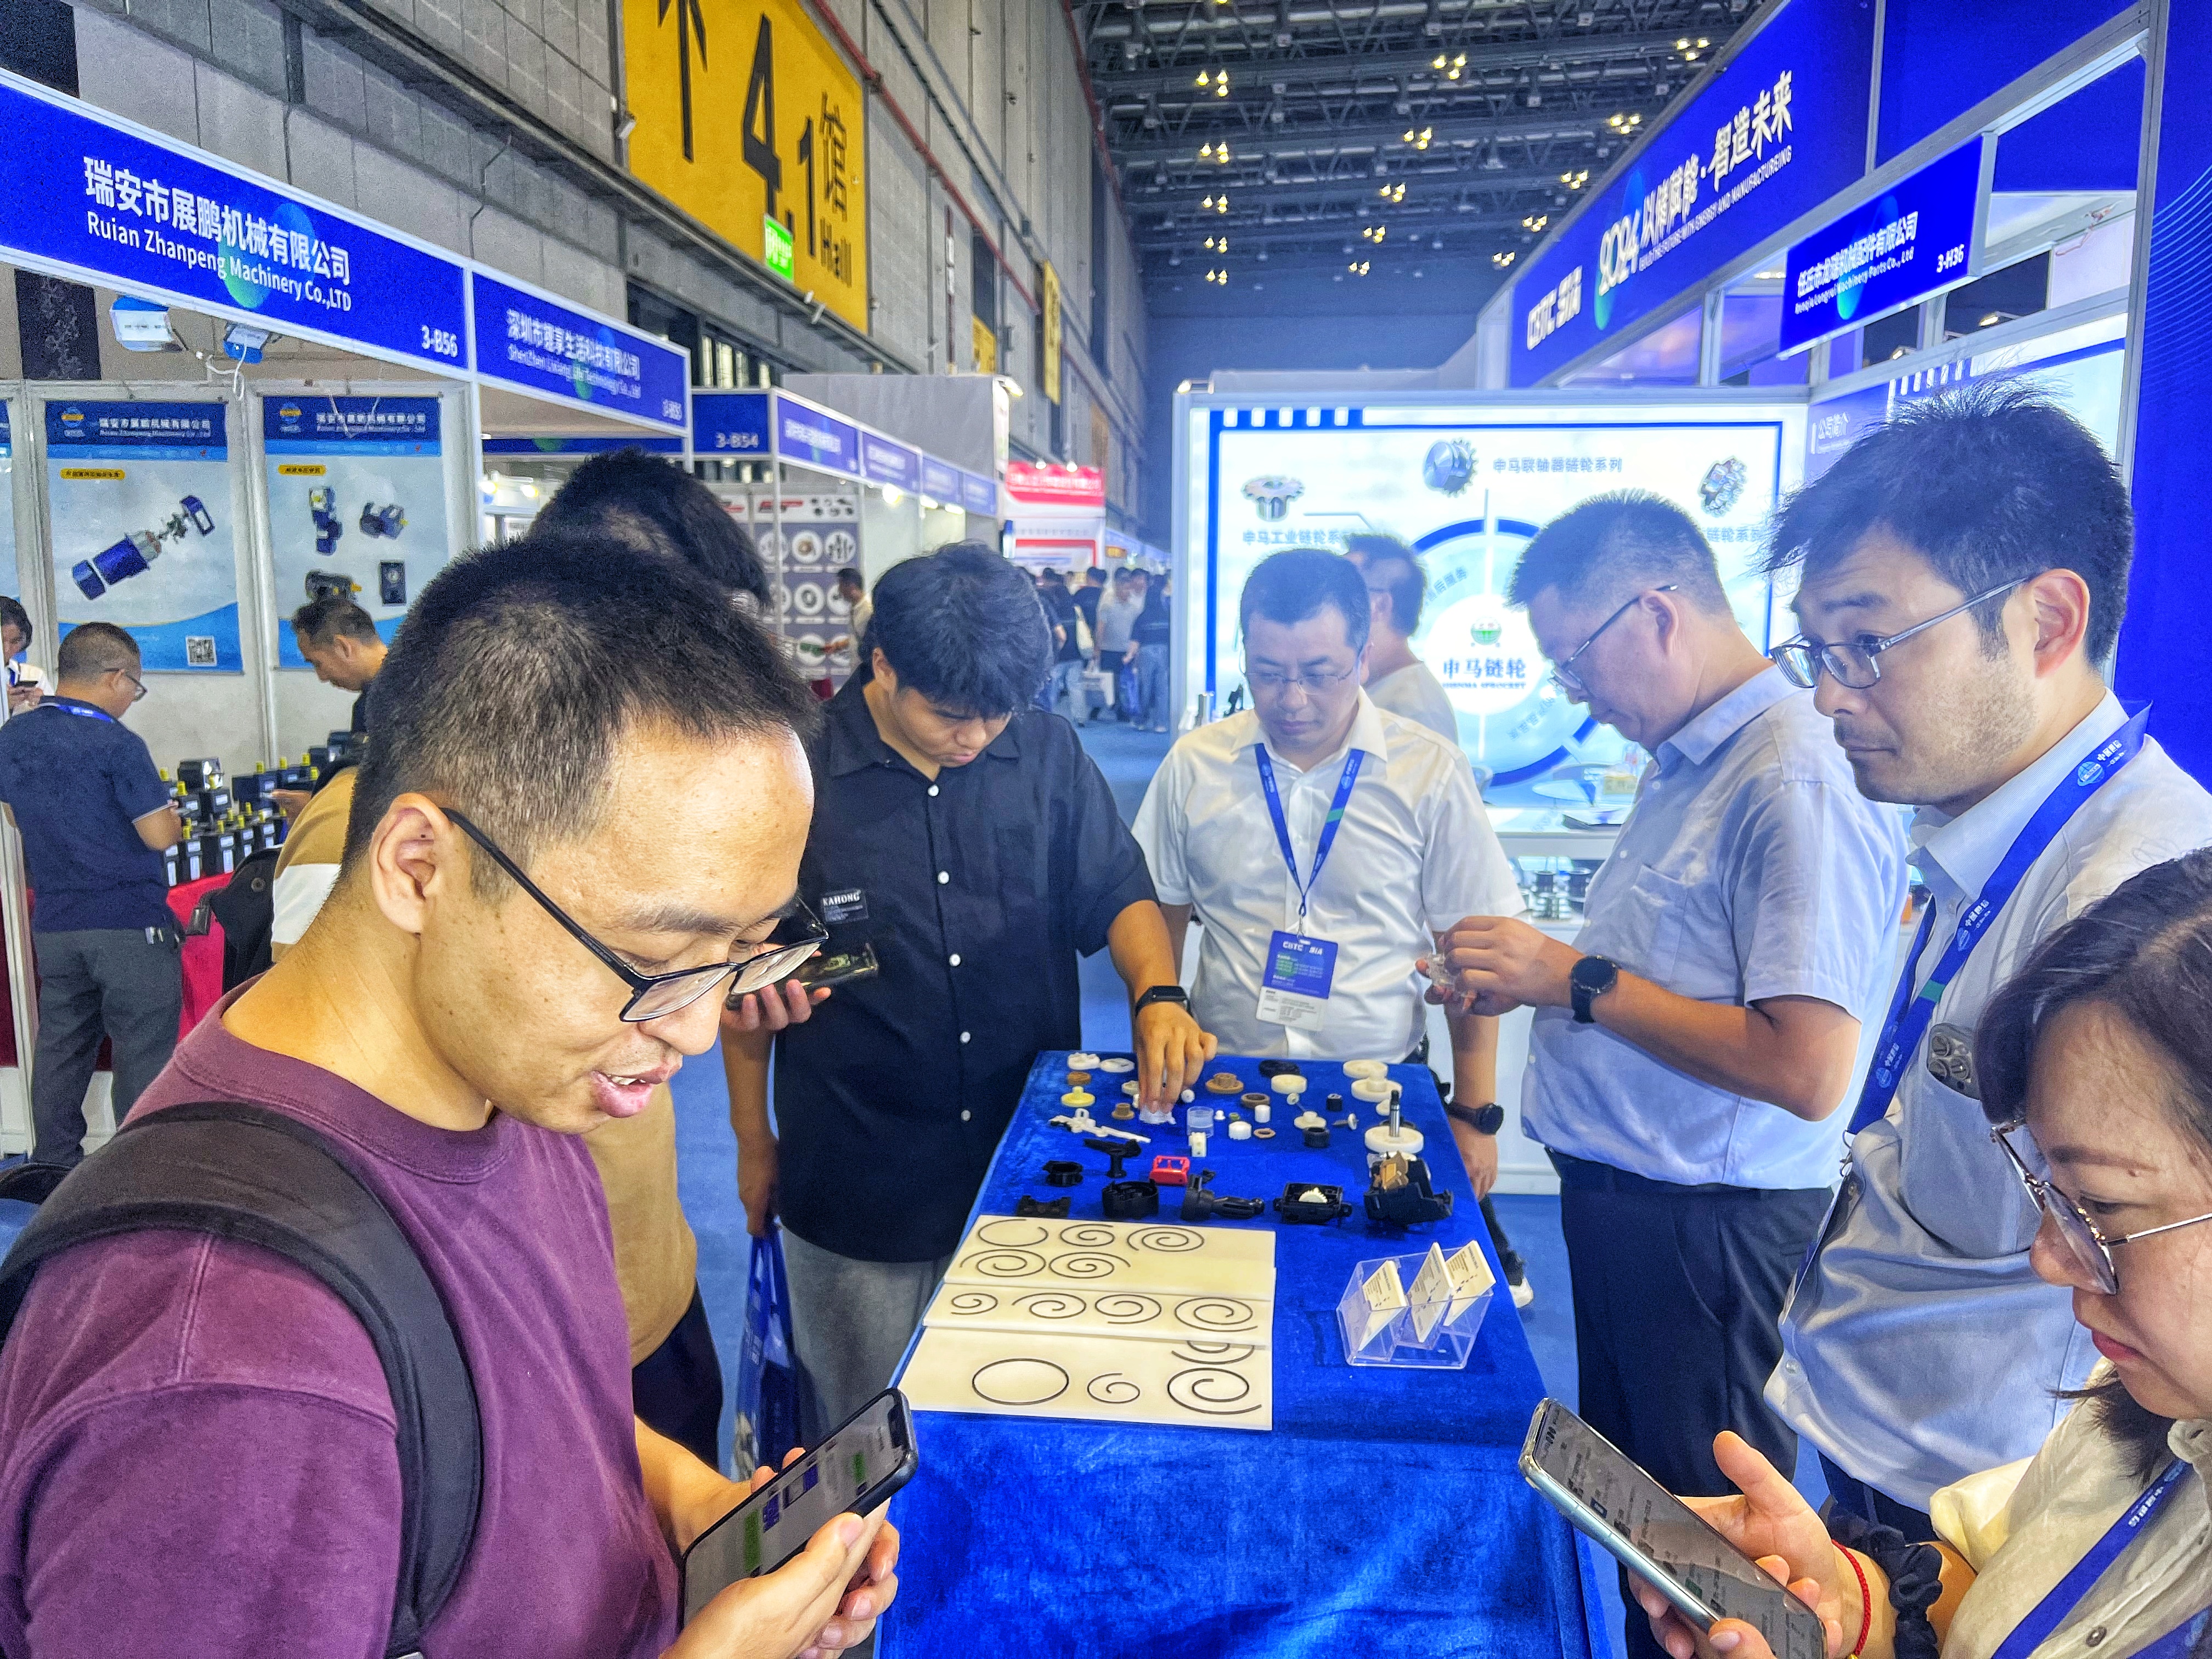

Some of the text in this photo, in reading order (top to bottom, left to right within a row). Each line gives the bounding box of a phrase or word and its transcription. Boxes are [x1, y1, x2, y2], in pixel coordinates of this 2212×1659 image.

[1718, 191, 1731, 215] AND
[83, 156, 350, 285] 瑞安市展鹏机械有限公司
[87, 211, 352, 312] Ruian Zhanpeng Machinery Co.,LTD
[820, 218, 852, 288] Hall
[1598, 208, 1640, 296] 2024
[1936, 243, 1965, 273] 3-H36
[1869, 261, 1887, 279] Parts
[421, 325, 459, 358] 3-B56
[715, 433, 759, 448] 3-B54
[1243, 528, 1351, 545] 申马工业链轮系
[1443, 658, 1526, 679] 申马链轮
